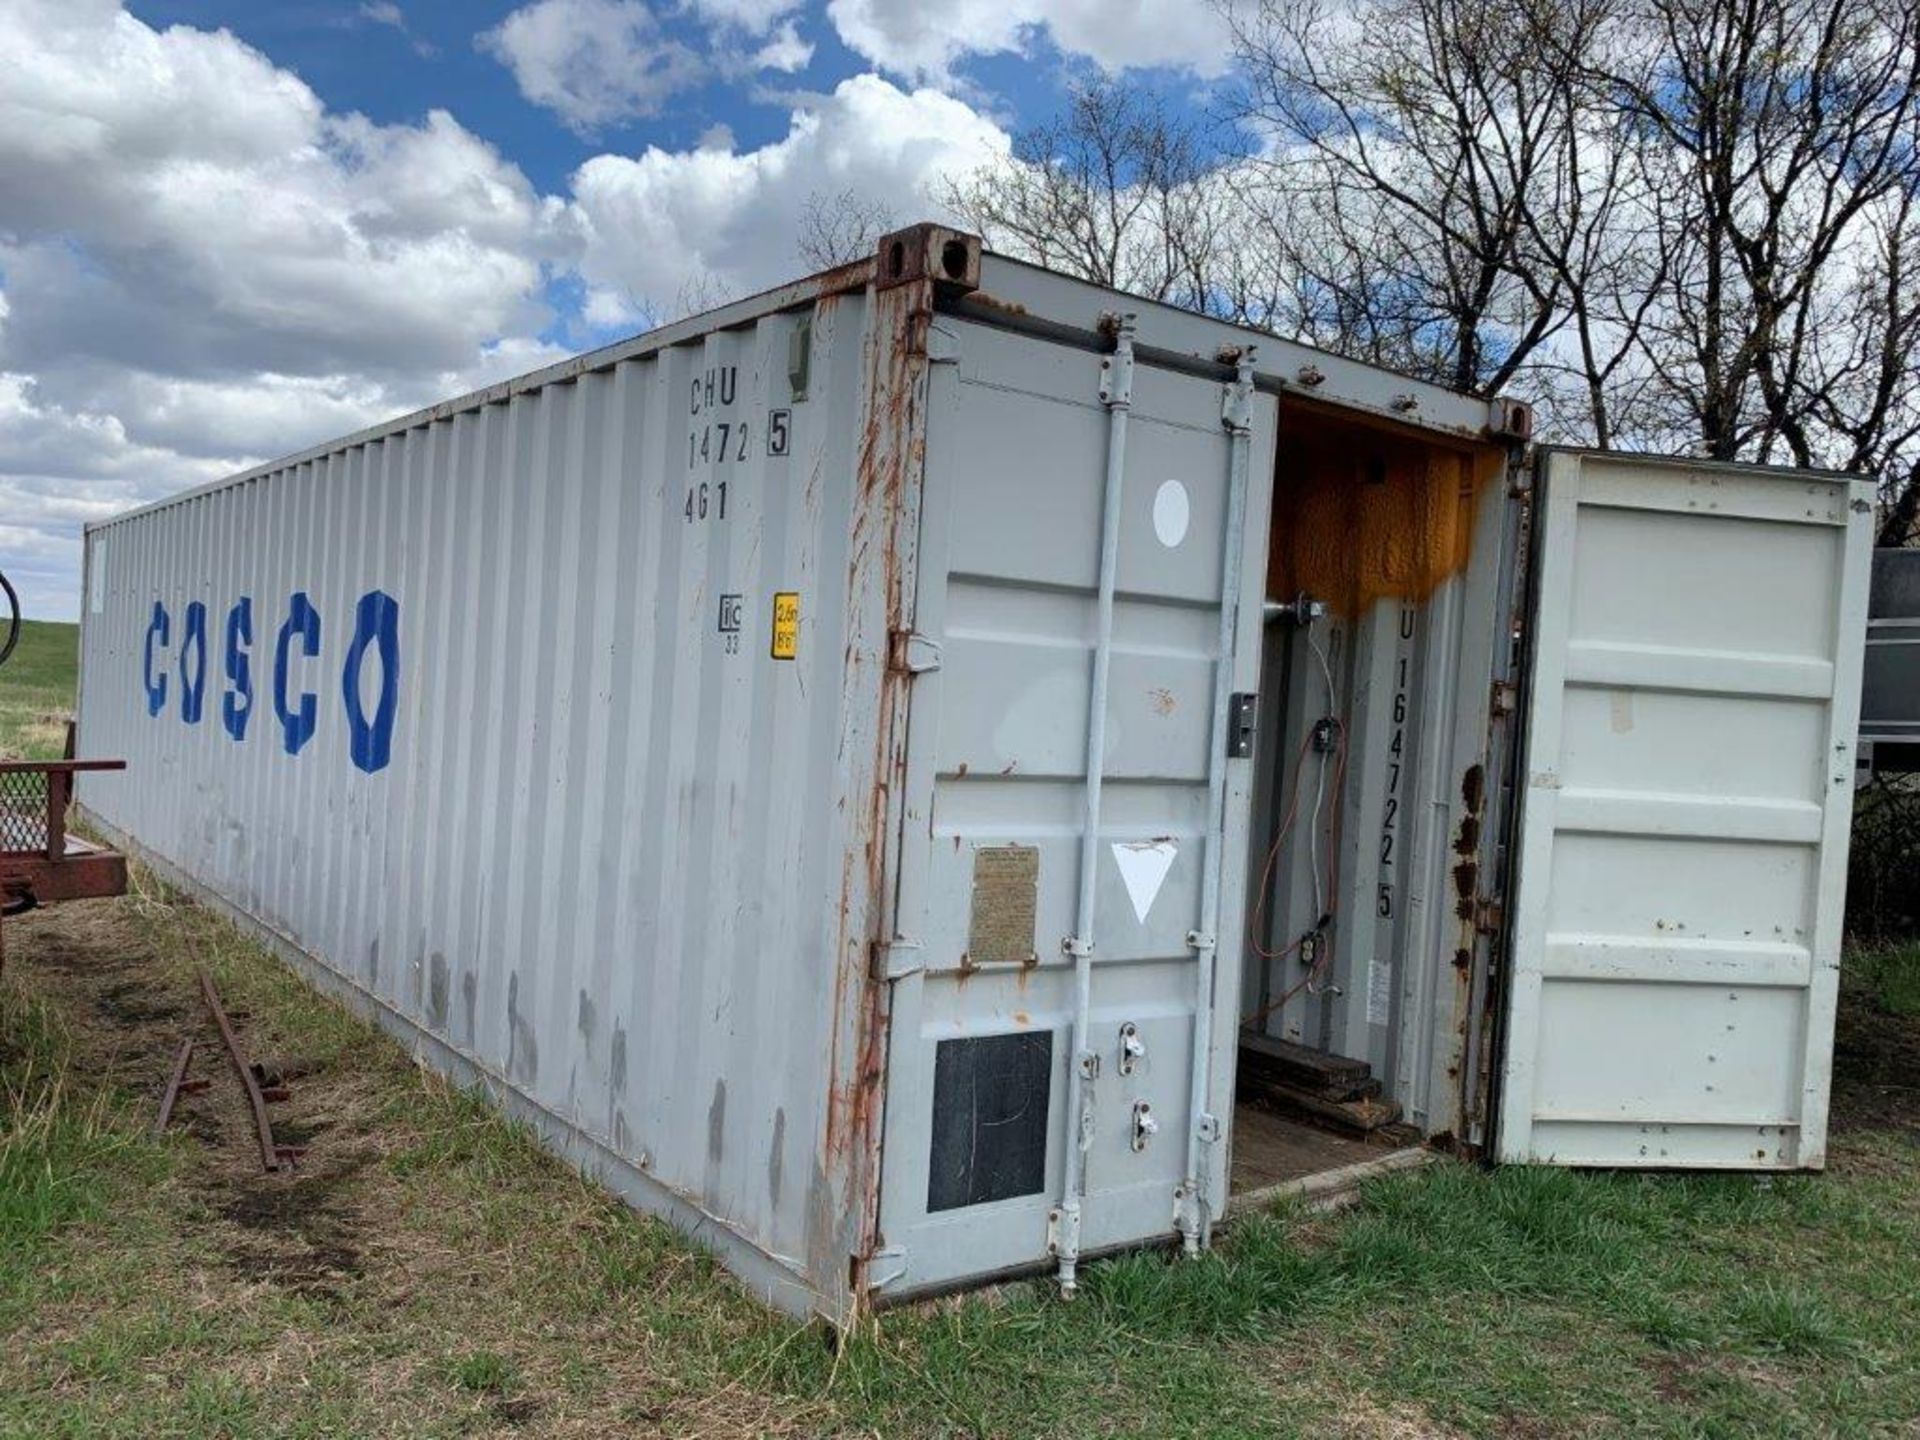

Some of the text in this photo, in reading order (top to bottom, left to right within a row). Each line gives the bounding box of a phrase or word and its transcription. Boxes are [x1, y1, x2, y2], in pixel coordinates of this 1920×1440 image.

[689, 412, 788, 469] 1472 5
[144, 589, 400, 774] COSCO
[1378, 886, 1392, 917] 5
